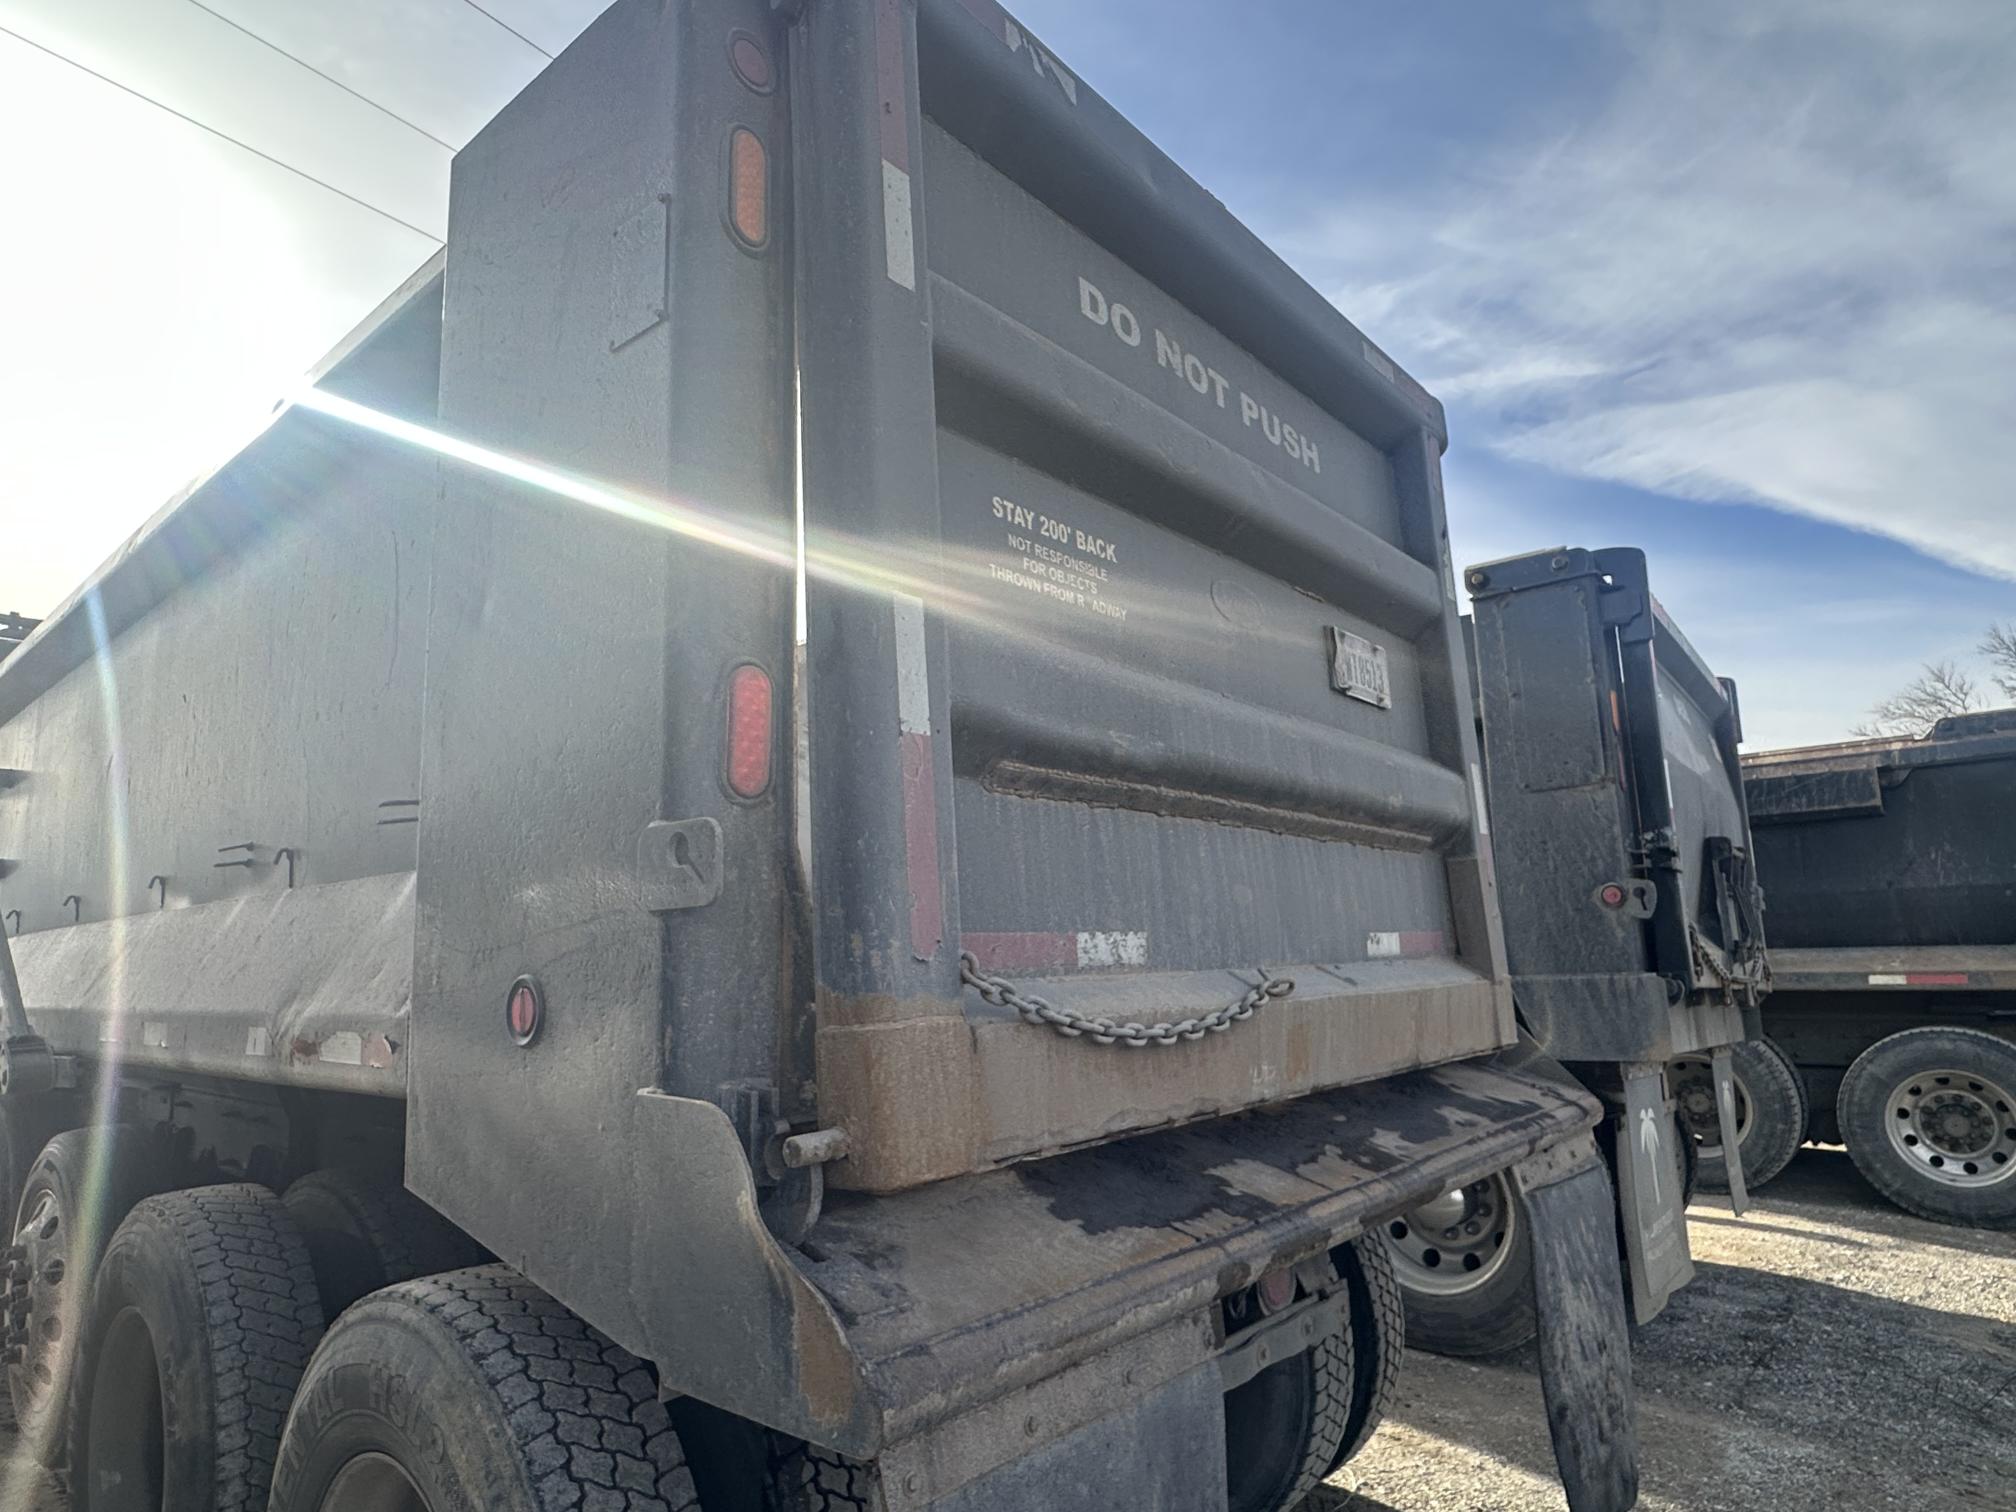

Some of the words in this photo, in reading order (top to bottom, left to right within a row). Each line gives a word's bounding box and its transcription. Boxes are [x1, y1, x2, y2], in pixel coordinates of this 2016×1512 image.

[1078, 276, 1141, 347] DO
[1154, 328, 1230, 409] NOT
[1240, 392, 1321, 474] PUSH
[992, 496, 1035, 530] STAY
[1040, 515, 1071, 544] 200'
[1076, 530, 1118, 563] BACK
[1008, 533, 1032, 553] NOT
[1035, 543, 1108, 582] RESPONSIBLE
[989, 563, 1041, 593] THROWN
[1043, 583, 1074, 604] FROM
[1077, 594, 1128, 621] RADWAY
[1023, 557, 1047, 576] FOR
[1049, 567, 1098, 594] OBJECTS
